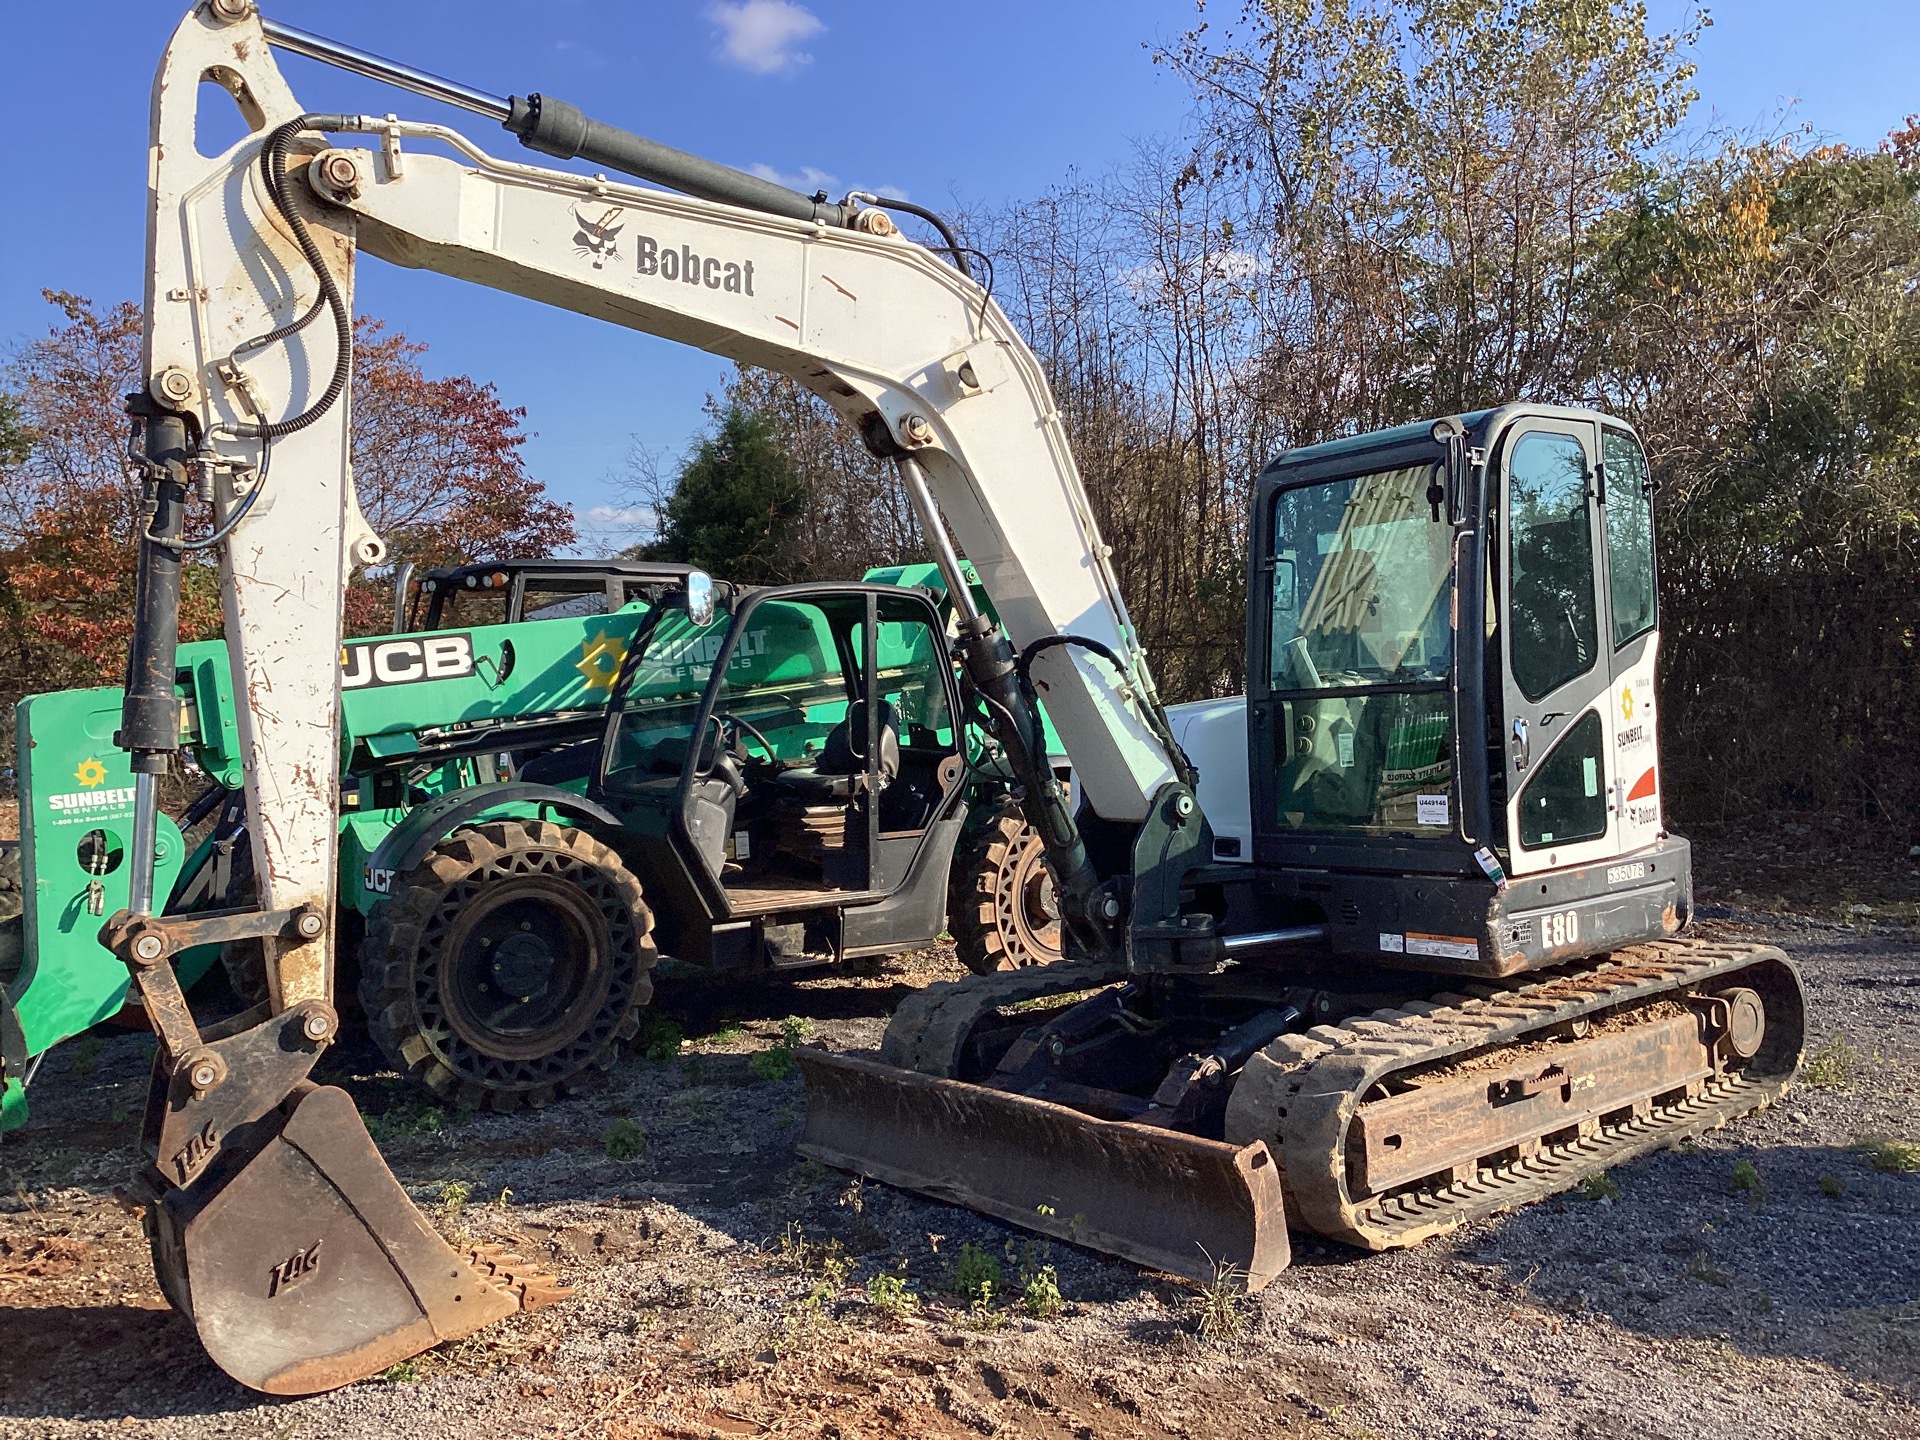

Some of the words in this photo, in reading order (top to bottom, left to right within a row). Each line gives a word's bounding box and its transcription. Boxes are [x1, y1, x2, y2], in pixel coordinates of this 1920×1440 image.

[637, 234, 754, 297] Bobcat
[342, 636, 473, 687] JCB
[661, 658, 752, 678] RENTLS
[1617, 725, 1643, 748] SUNBELT
[48, 787, 136, 810] SUNBELT
[63, 803, 126, 815] RENTALS
[1638, 804, 1657, 825] Bobcat
[1608, 863, 1644, 883] 535078
[1541, 910, 1578, 949] E80
